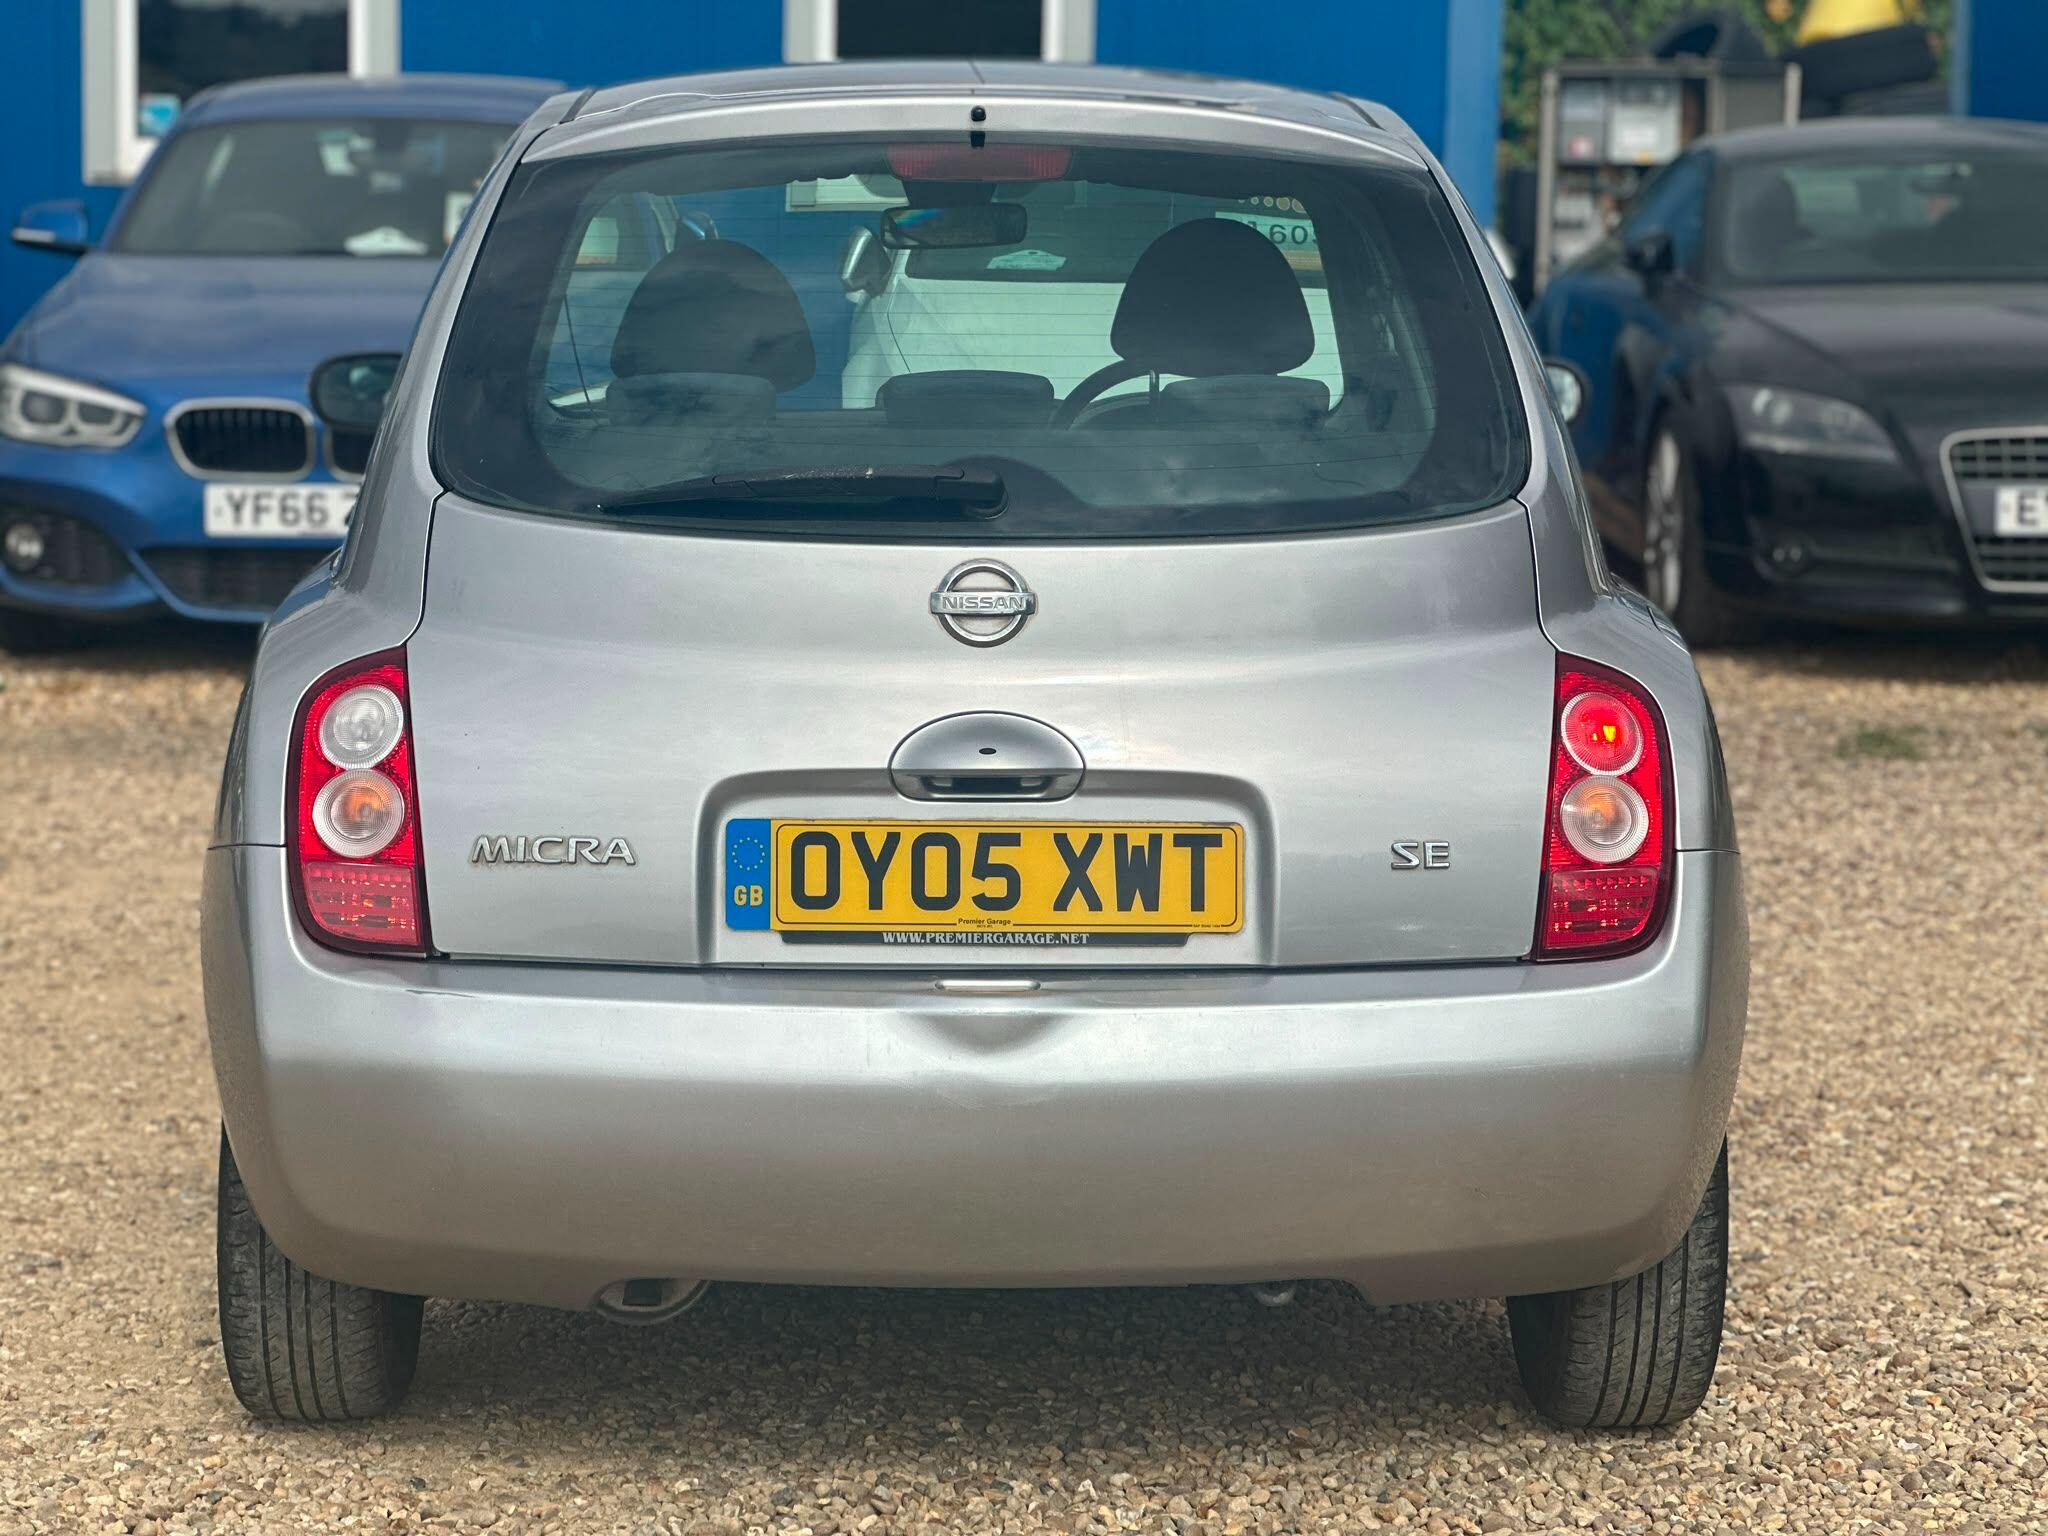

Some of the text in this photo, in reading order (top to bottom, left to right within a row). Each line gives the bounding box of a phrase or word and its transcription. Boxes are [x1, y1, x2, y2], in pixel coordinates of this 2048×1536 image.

[226, 491, 328, 527] YF66
[2017, 491, 2048, 526] E
[942, 596, 1025, 609] NISSAN
[472, 835, 636, 865] MICRA
[1391, 841, 1450, 870] SE
[791, 831, 1222, 912] OY05 XWT
[733, 885, 763, 906] GB
[958, 917, 985, 925] Premier
[987, 918, 1011, 926] Garage
[882, 932, 1090, 944] WWW.PREMIERGARAGE.NET
